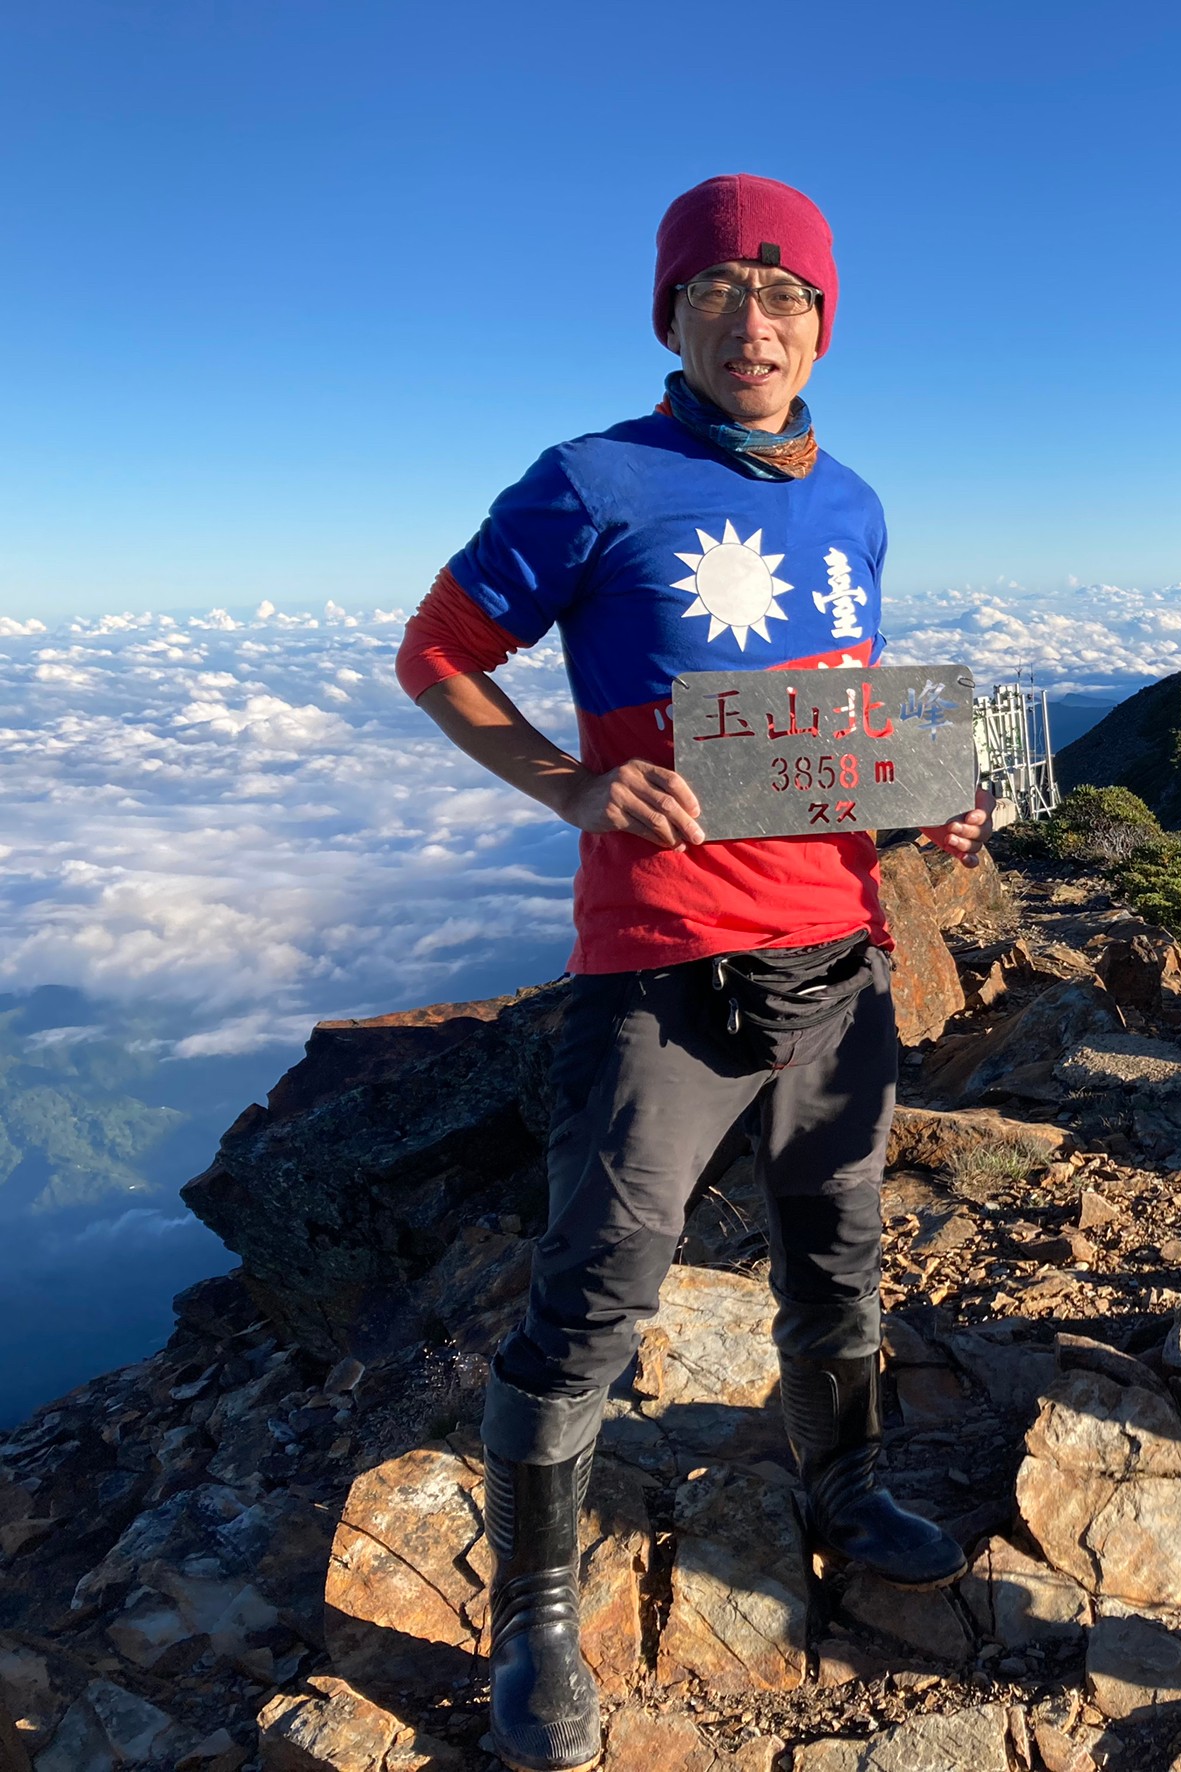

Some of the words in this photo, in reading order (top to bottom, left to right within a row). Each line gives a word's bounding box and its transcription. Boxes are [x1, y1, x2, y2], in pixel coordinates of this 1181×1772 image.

[812, 547, 867, 669] 臺
[692, 679, 959, 741] 玉山北峰
[771, 753, 859, 792] 3858
[875, 758, 895, 784] m
